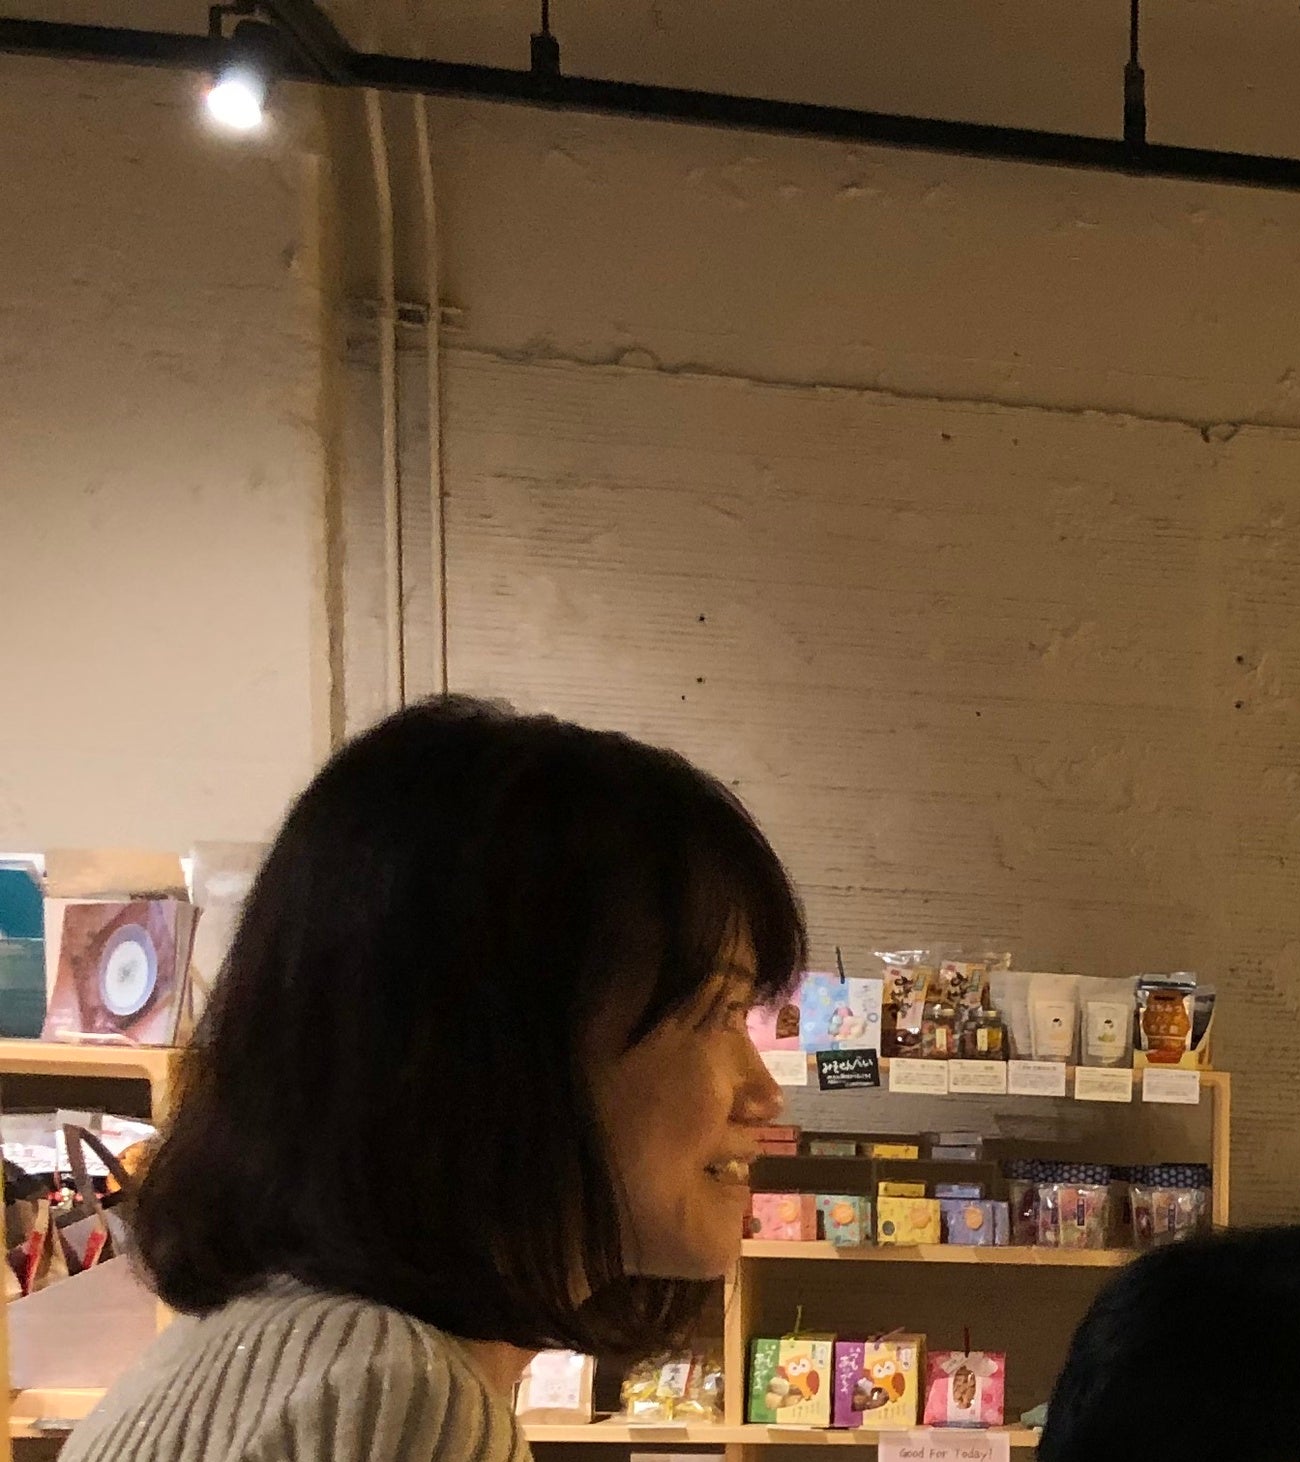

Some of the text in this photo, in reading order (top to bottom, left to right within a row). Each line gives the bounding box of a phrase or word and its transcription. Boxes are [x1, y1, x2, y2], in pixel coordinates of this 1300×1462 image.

[899, 1447, 993, 1462] Good For Today!
